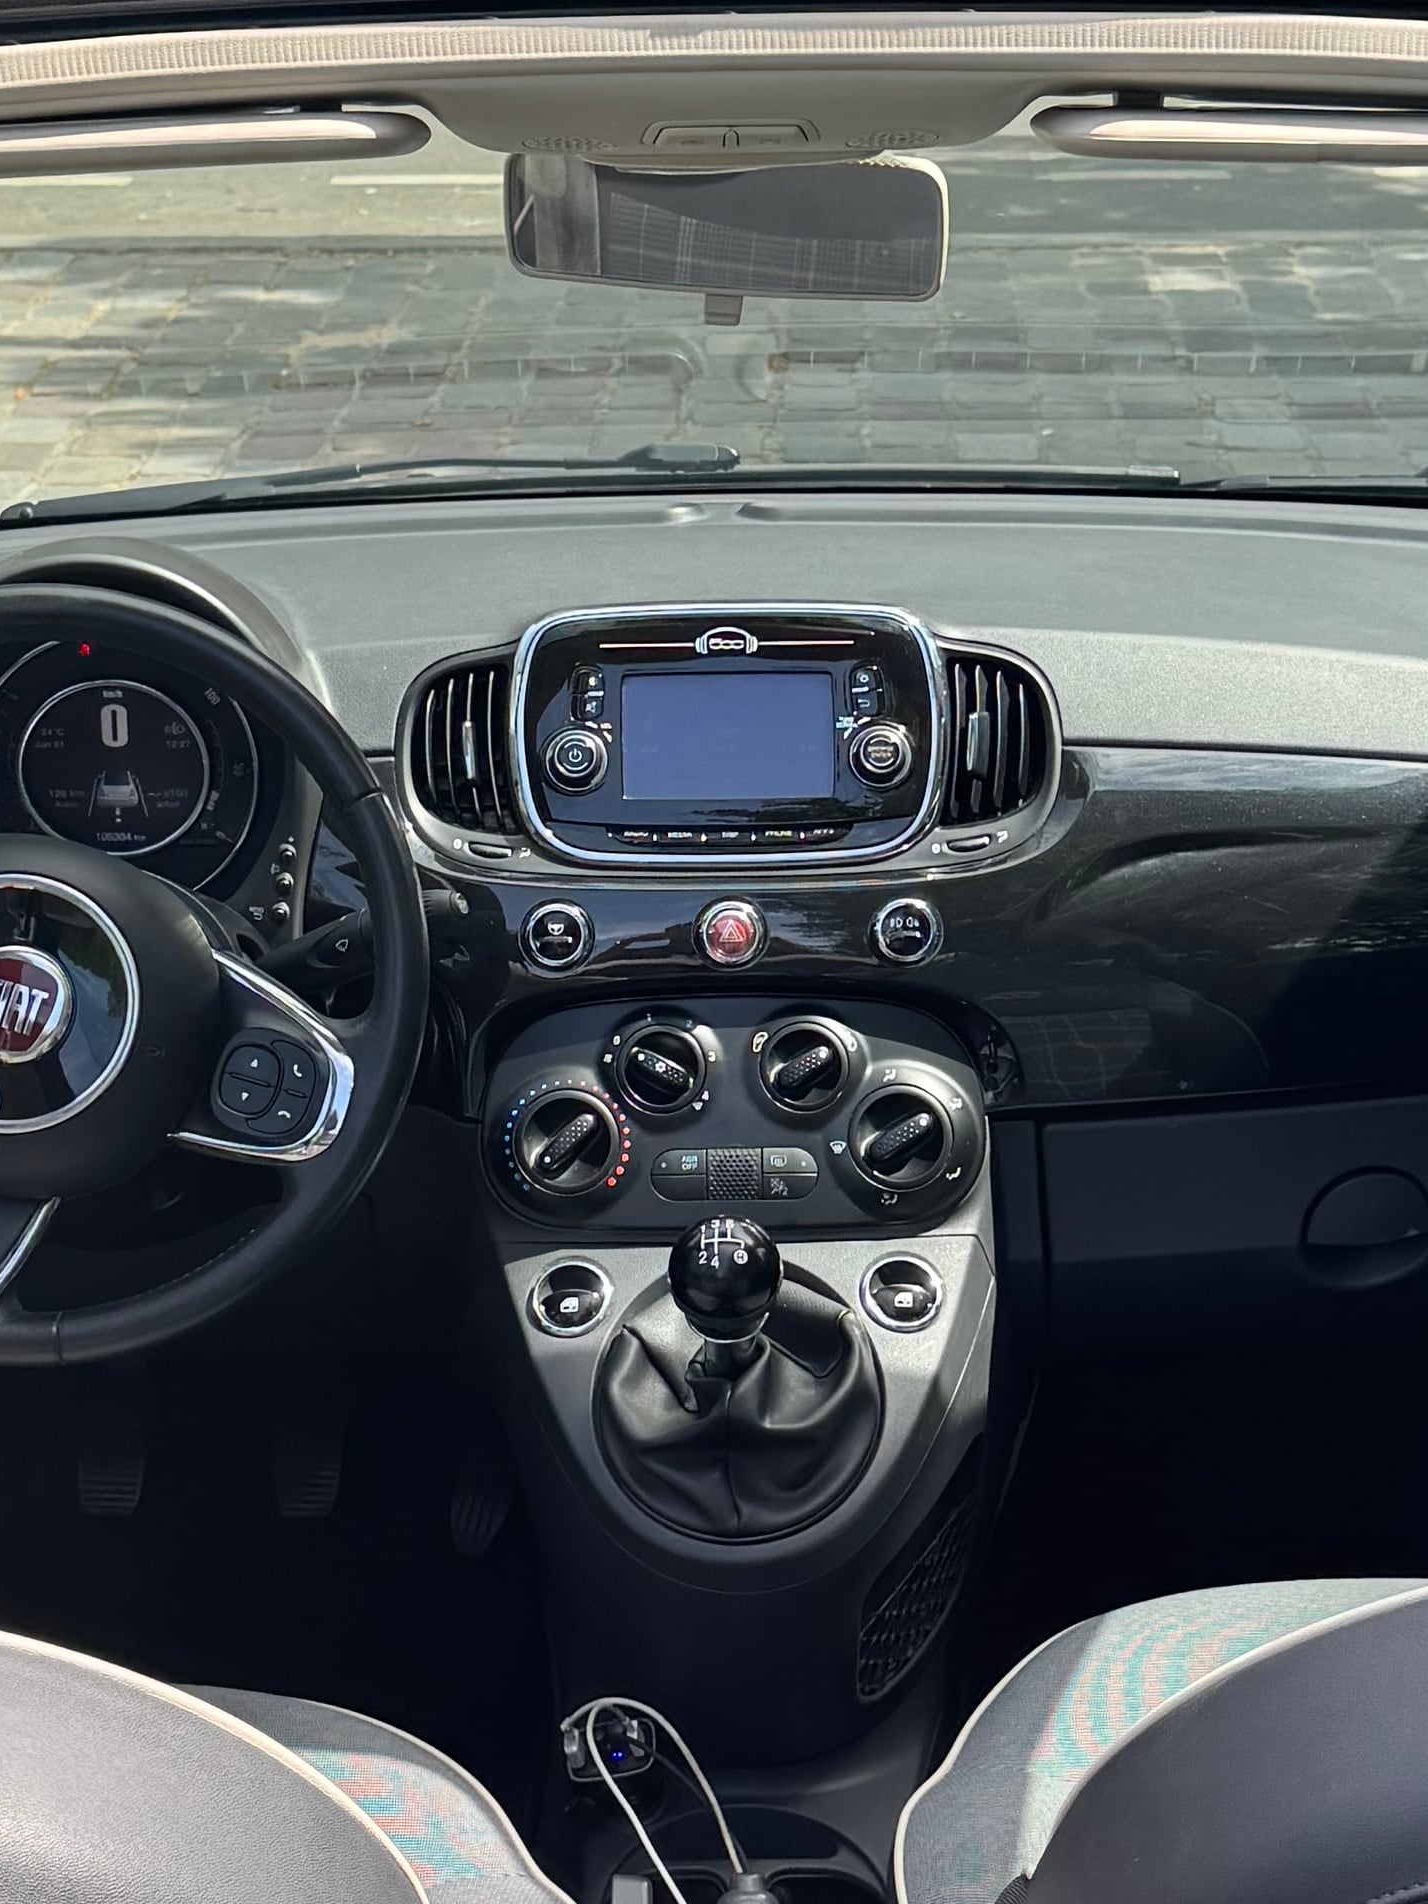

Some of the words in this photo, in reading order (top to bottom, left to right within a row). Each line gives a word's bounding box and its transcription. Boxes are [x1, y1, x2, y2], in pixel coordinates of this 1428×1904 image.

[100, 703, 129, 748] 0
[698, 1250, 708, 1265] 2
[710, 1255, 720, 1270] 4
